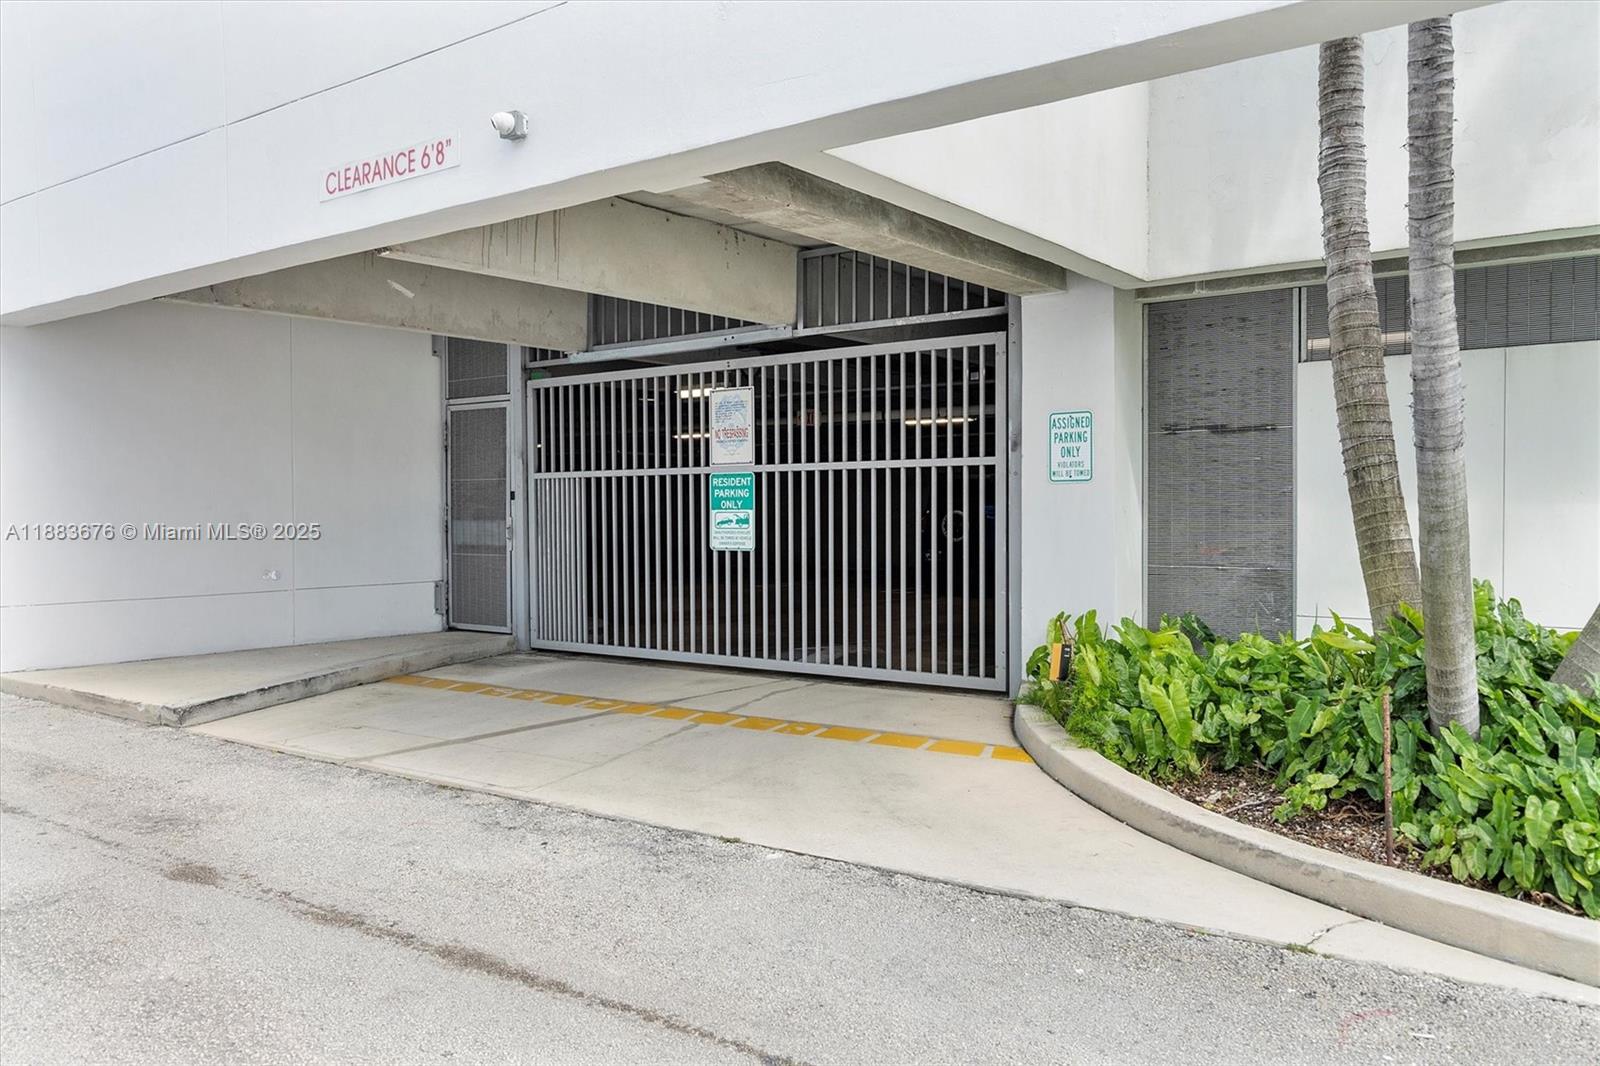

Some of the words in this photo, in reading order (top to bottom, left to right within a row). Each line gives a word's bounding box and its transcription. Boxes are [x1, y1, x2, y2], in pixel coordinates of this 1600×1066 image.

[326, 149, 416, 195] CLEARANCE
[1052, 416, 1090, 430] ASSIGNED
[1054, 431, 1088, 444] PARKING
[1060, 446, 1081, 458] ONLY
[713, 477, 752, 487] RESIDENT
[714, 489, 750, 498] PARKING
[720, 500, 743, 509] ONLY
